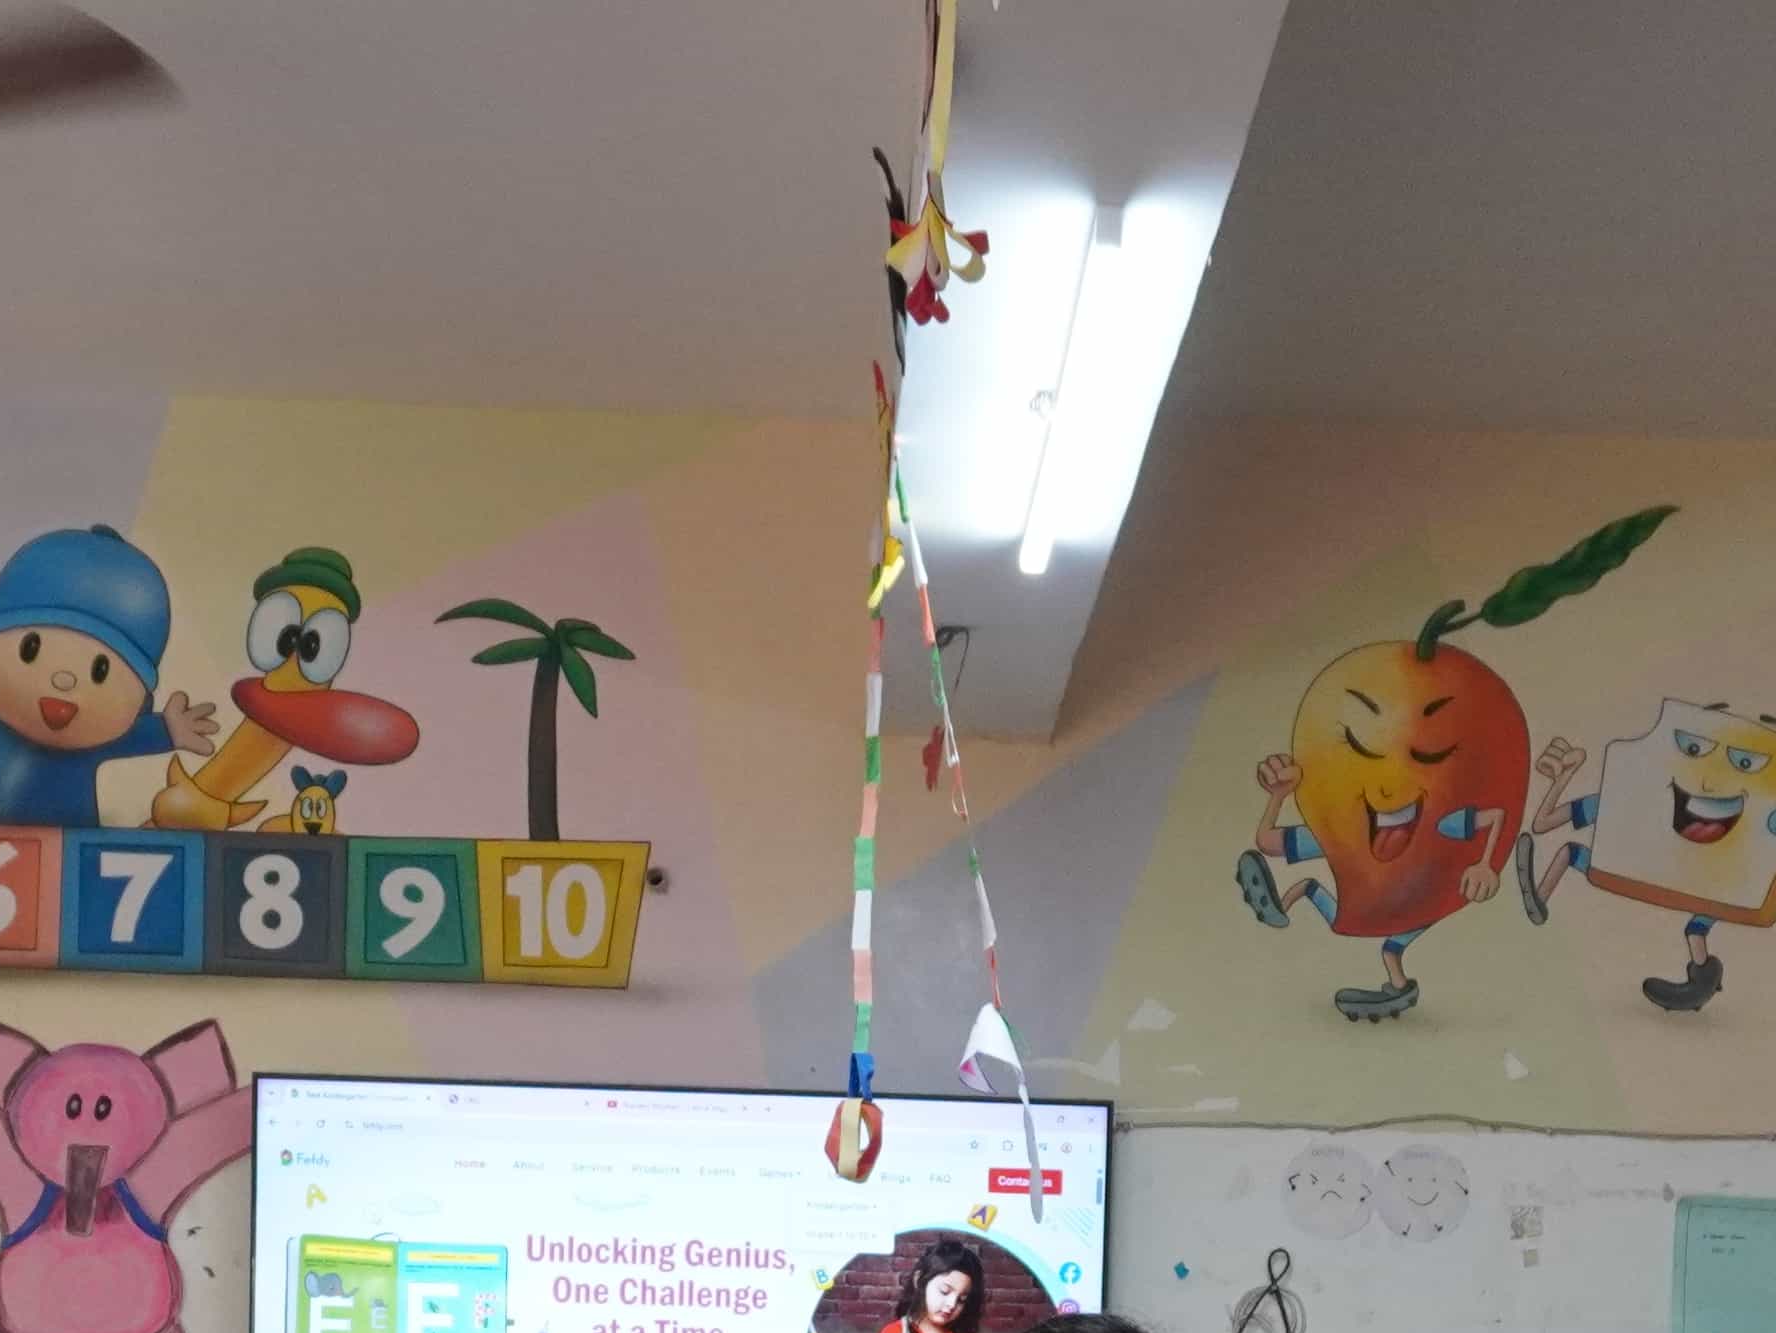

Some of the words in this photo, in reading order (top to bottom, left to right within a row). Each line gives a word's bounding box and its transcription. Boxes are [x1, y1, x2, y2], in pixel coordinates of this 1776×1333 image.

[98, 851, 175, 943] 7
[239, 853, 304, 951] 8
[379, 866, 446, 959] 9
[503, 863, 606, 961] 10
[454, 1157, 487, 1170] Home
[631, 1164, 681, 1177] Products
[699, 1166, 736, 1179] Events
[929, 1173, 953, 1186] FAQ
[997, 1174, 1034, 1190] Conta
[526, 1234, 676, 1272] Unlocking
[685, 1240, 795, 1275] Genius,
[552, 1276, 609, 1304] One
[619, 1279, 768, 1316] Challenge
